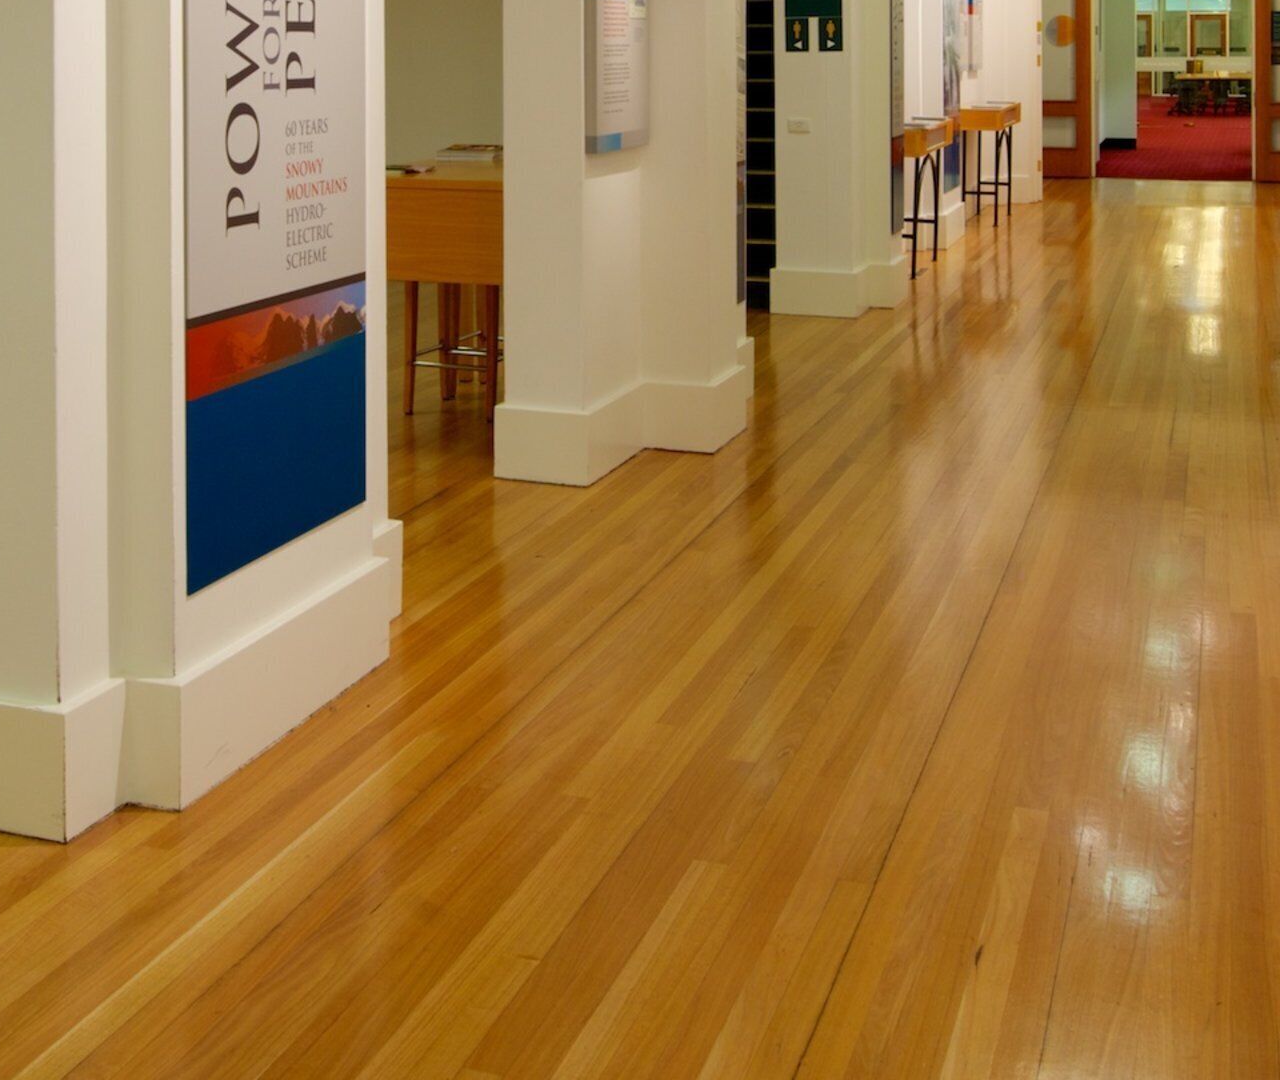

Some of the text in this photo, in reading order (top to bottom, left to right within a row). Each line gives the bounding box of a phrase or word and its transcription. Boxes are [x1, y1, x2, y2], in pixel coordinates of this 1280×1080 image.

[285, 117, 328, 138] 60 YEARS
[285, 140, 314, 156] OF THE
[285, 158, 325, 179] SNOWY
[285, 176, 348, 202] MOUNTAINS
[286, 202, 329, 225] HYDRO-
[286, 222, 334, 248] ELECTRIC
[286, 245, 327, 271] SCHEME
